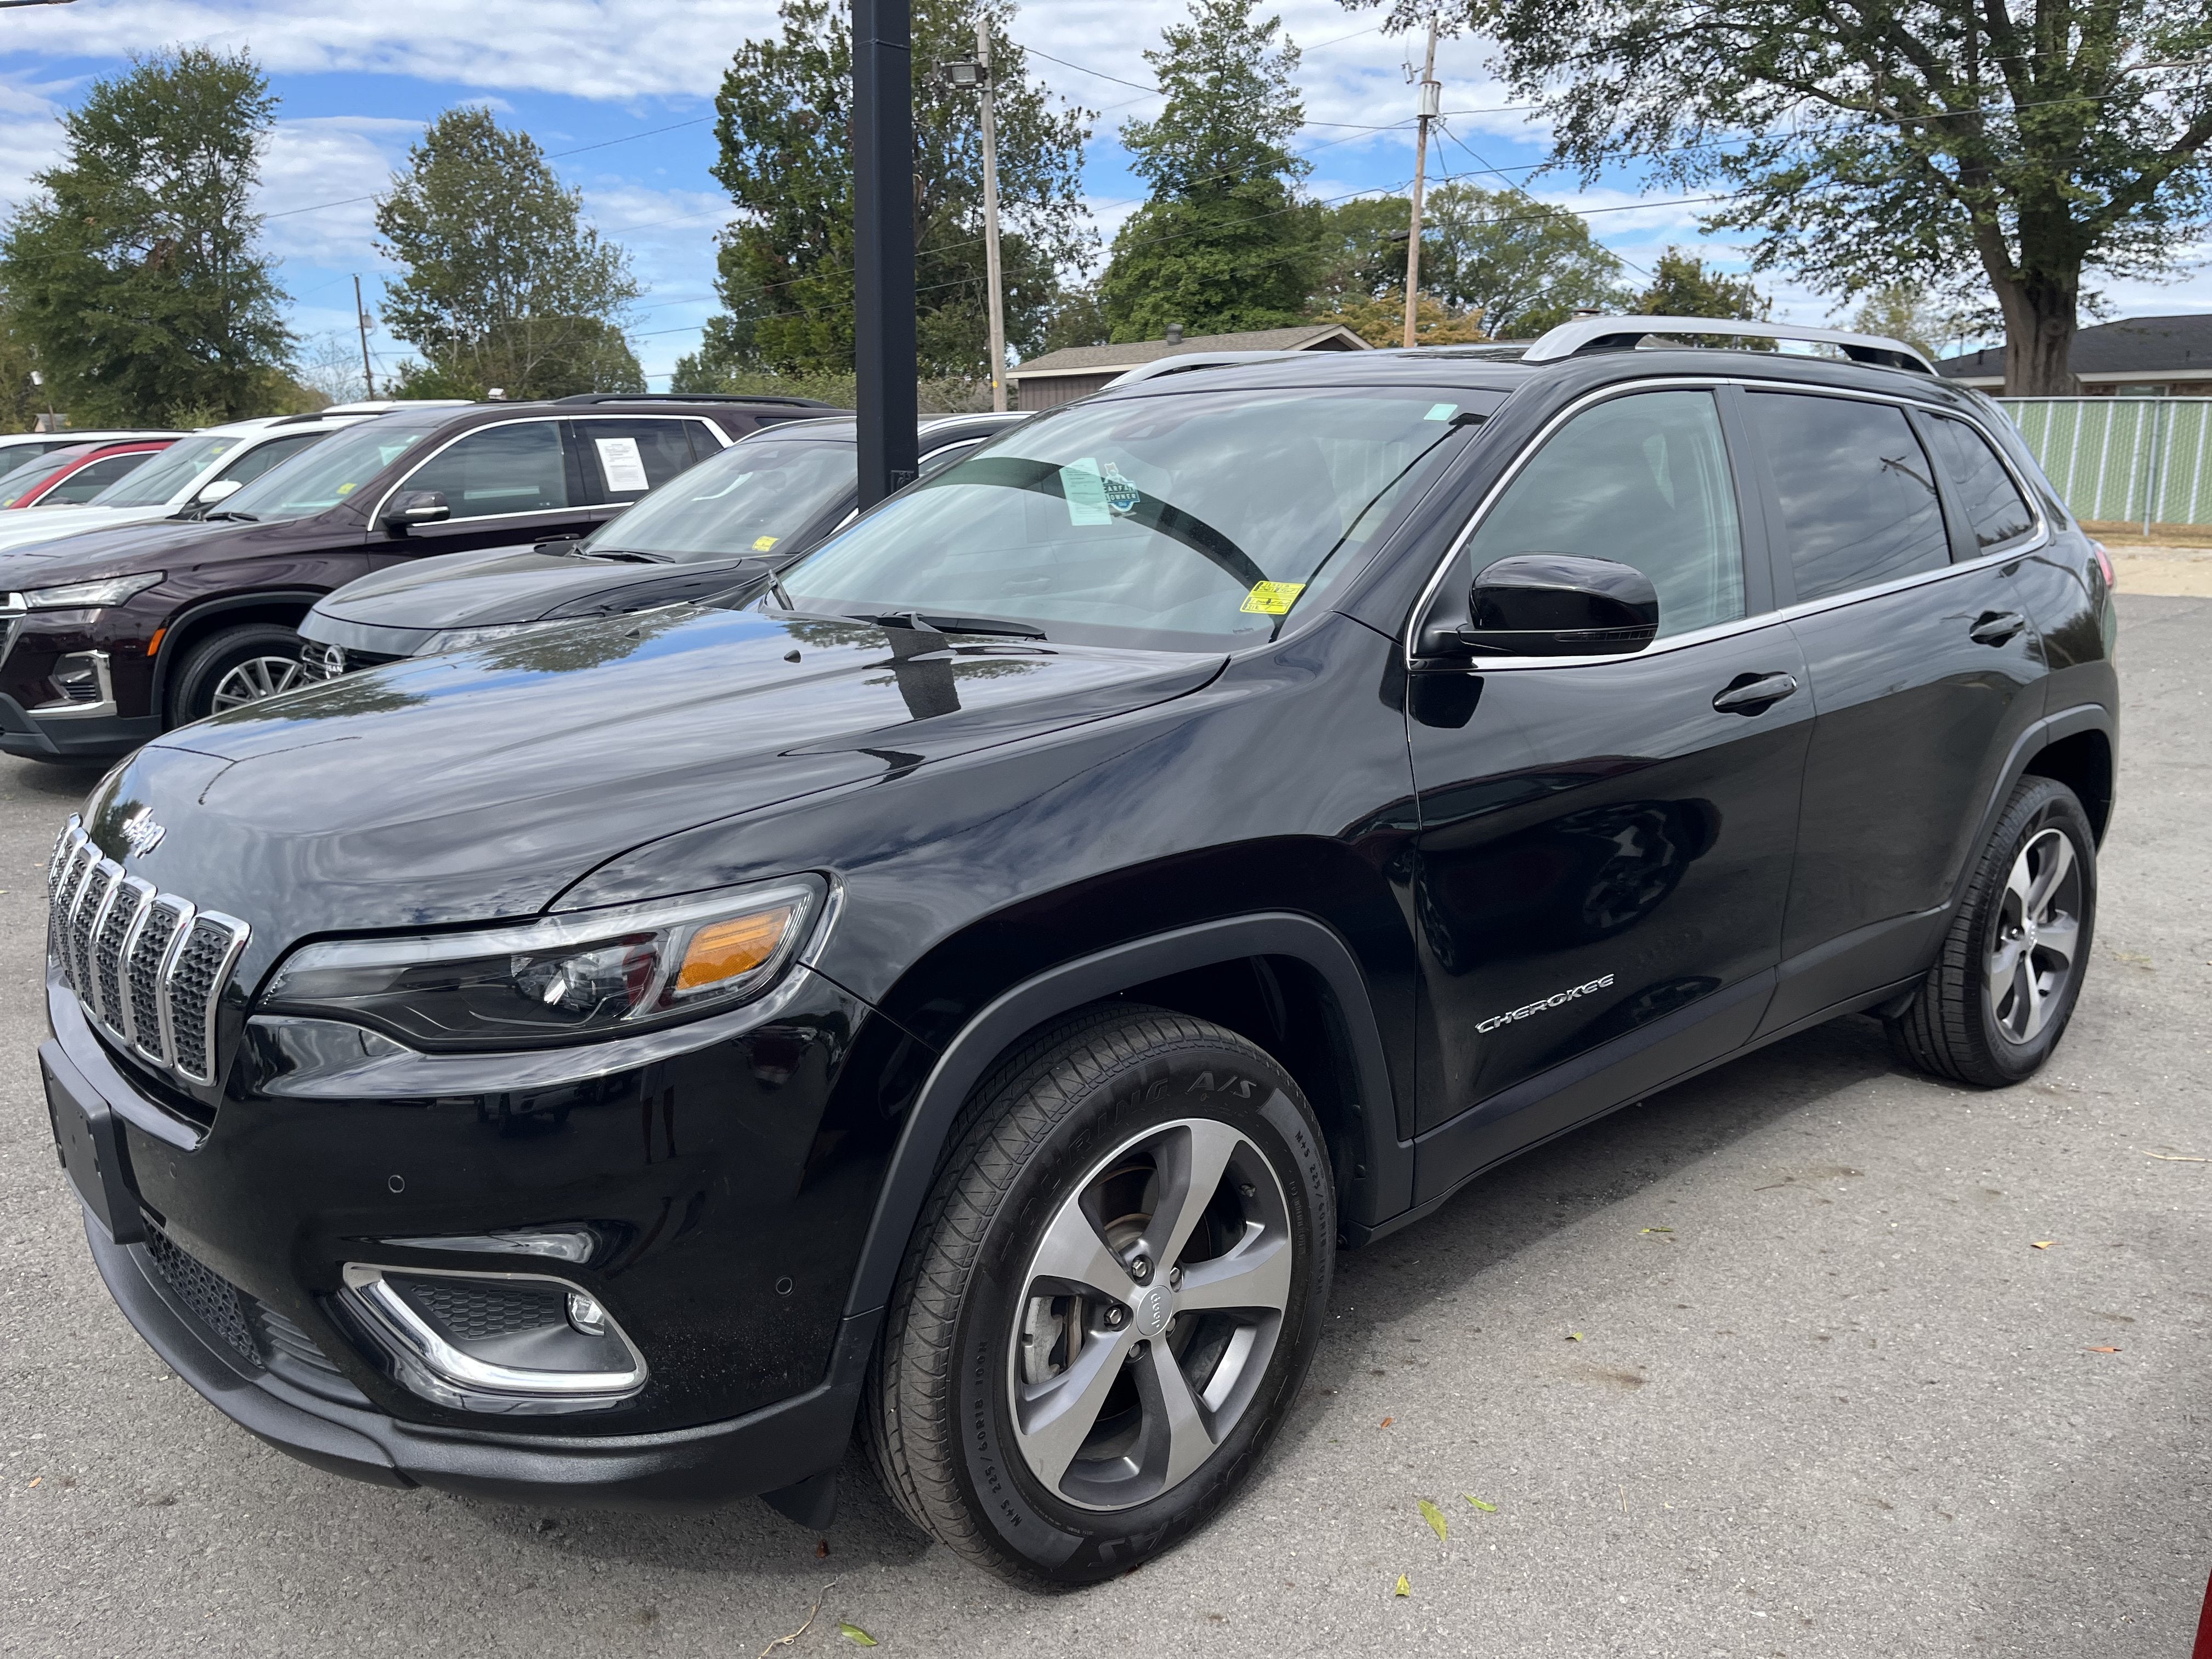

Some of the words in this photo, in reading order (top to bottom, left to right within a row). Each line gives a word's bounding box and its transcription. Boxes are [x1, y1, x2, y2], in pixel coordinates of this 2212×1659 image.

[1110, 493, 1136, 501] OWNER
[1475, 973, 1615, 1034] CHEROKEE
[1185, 1070, 1257, 1100] A/S
[974, 1341, 986, 1386] 100H
[1000, 1498, 1023, 1527] M+S
